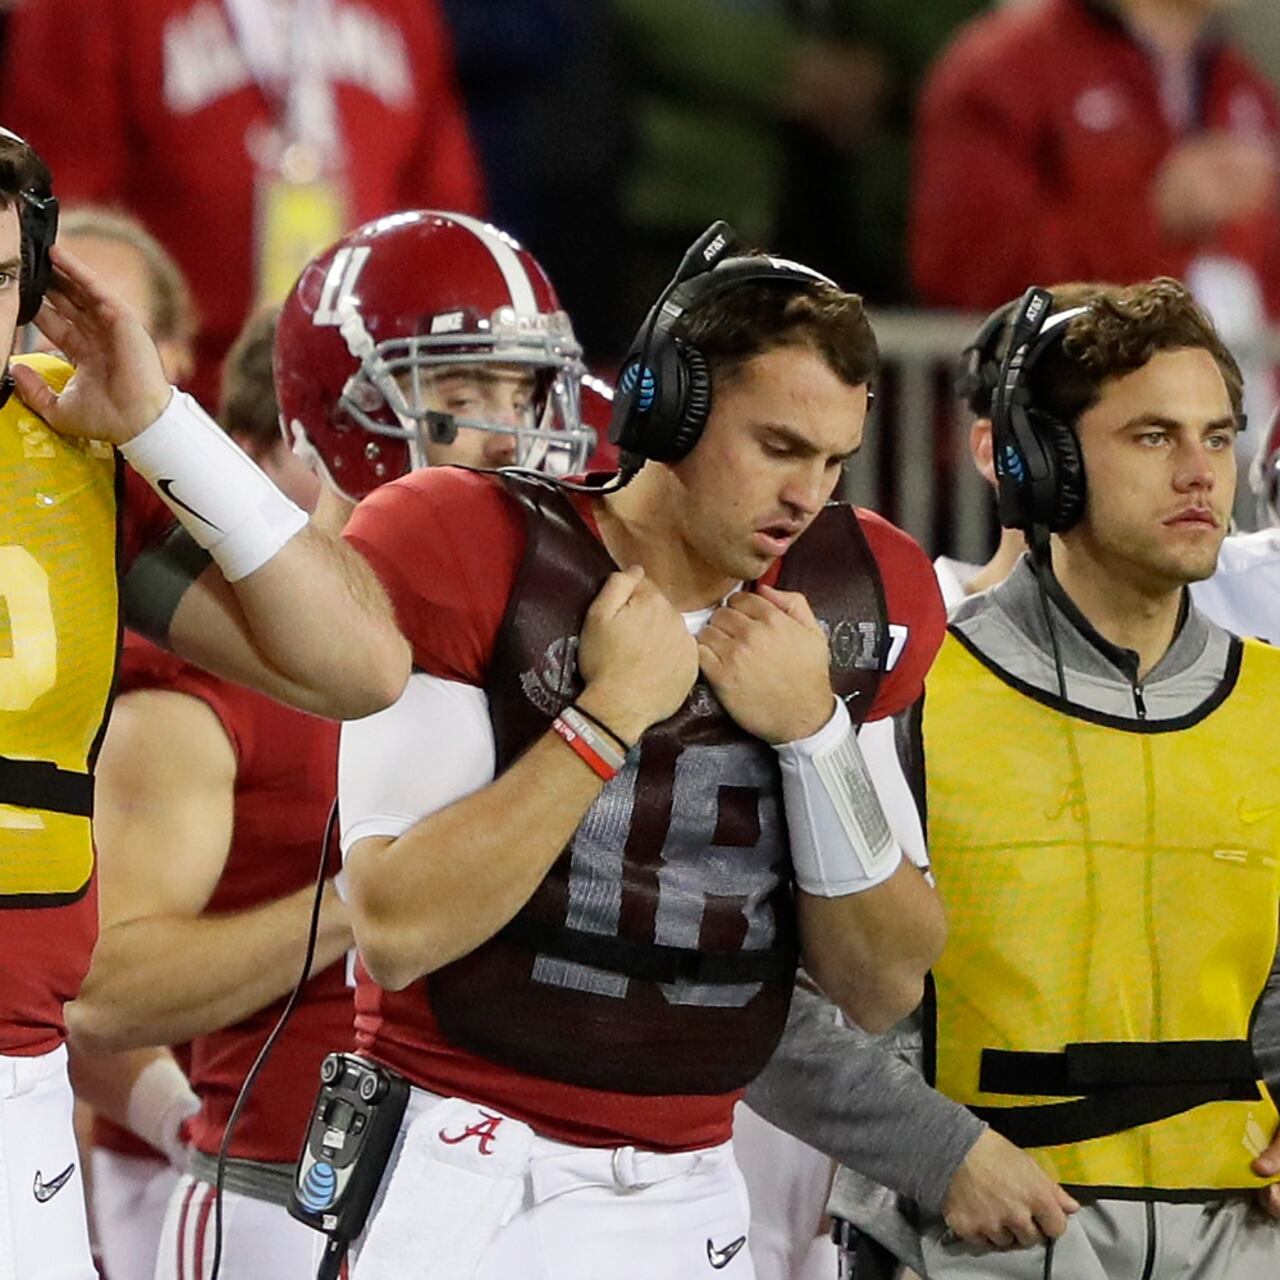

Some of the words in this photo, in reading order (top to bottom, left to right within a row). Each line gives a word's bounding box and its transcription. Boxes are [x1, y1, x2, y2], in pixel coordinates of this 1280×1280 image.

[703, 234, 727, 262] AT&T
[530, 743, 783, 1008] 18
[438, 1108, 504, 1156] A
